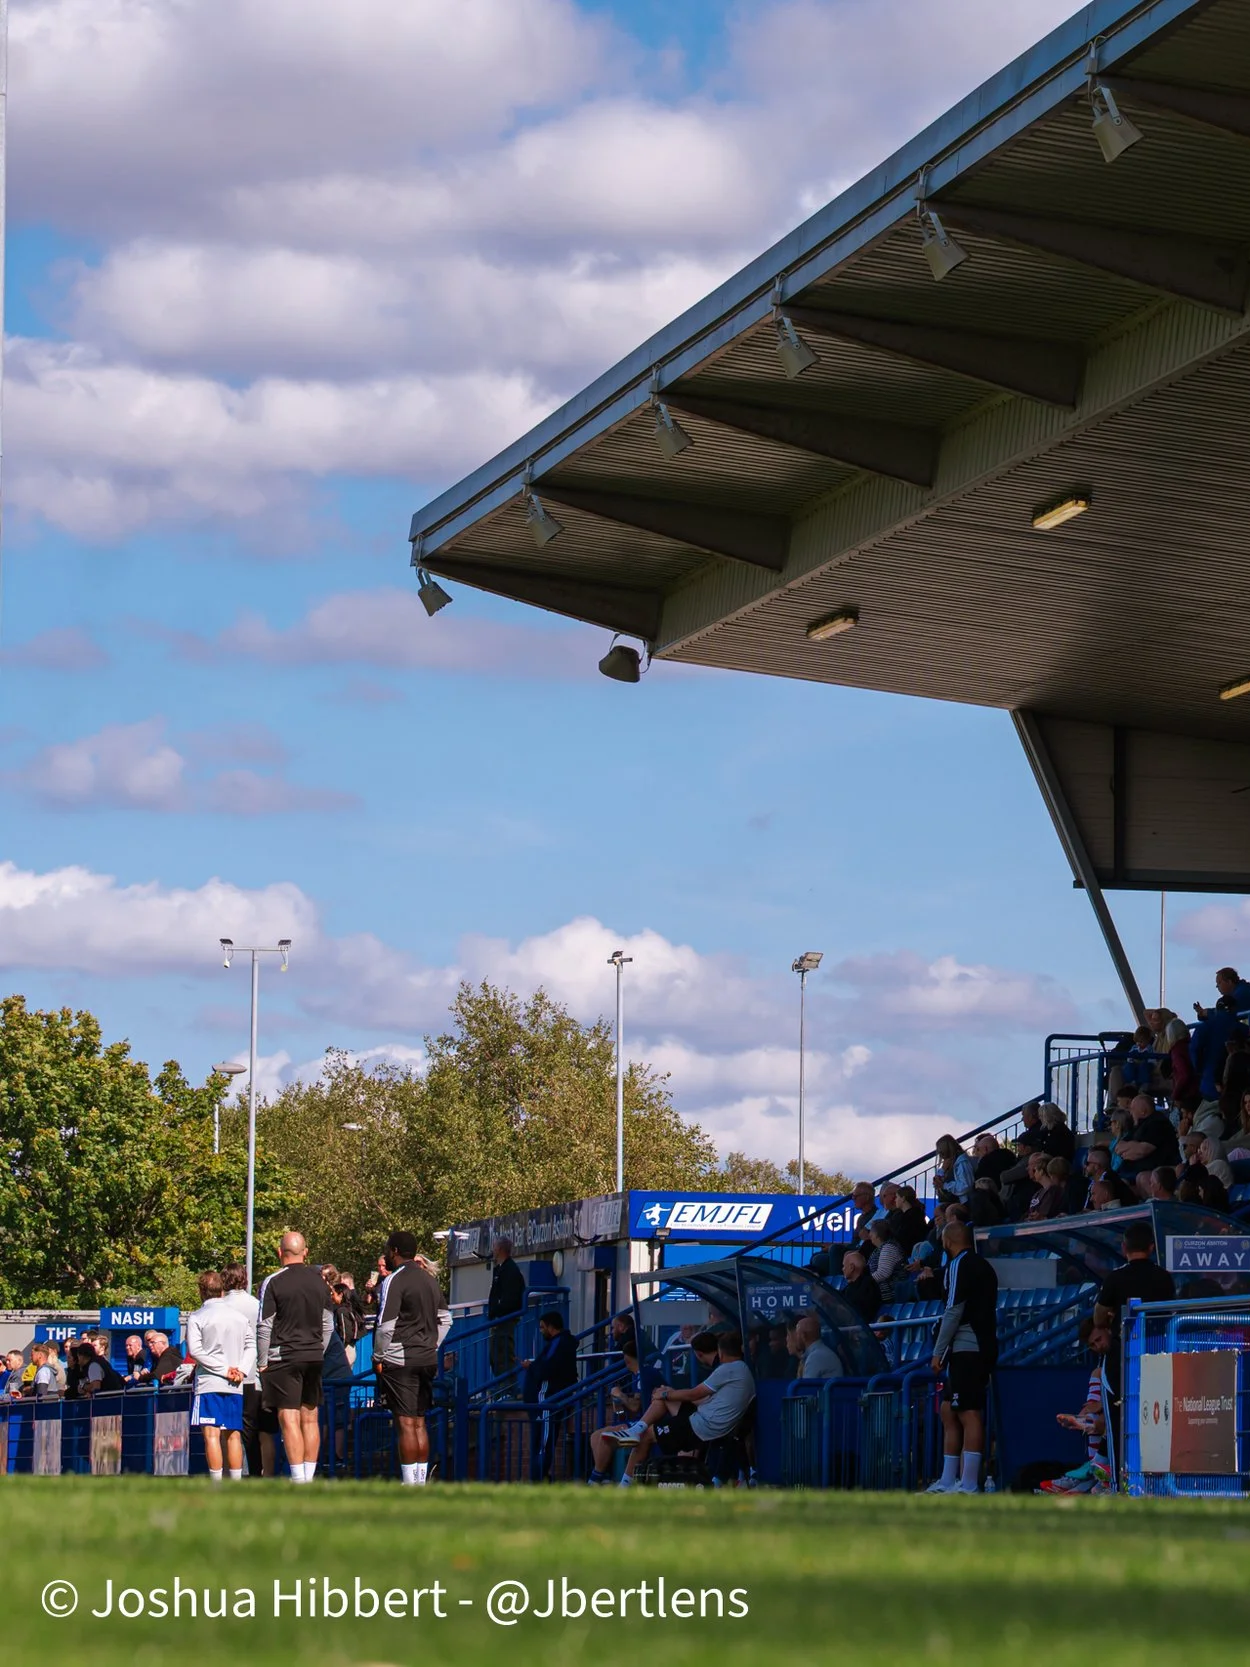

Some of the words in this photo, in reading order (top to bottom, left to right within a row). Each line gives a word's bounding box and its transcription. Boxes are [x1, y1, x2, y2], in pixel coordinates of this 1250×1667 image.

[673, 1204, 762, 1224] EMJFL
[1179, 1252, 1246, 1267] AWAY
[751, 1295, 808, 1308] HOME
[111, 1311, 155, 1326] NASH
[46, 1326, 77, 1340] THE
[1183, 1396, 1202, 1412] National
[1203, 1395, 1221, 1416] League
[1221, 1395, 1233, 1411] Trust
